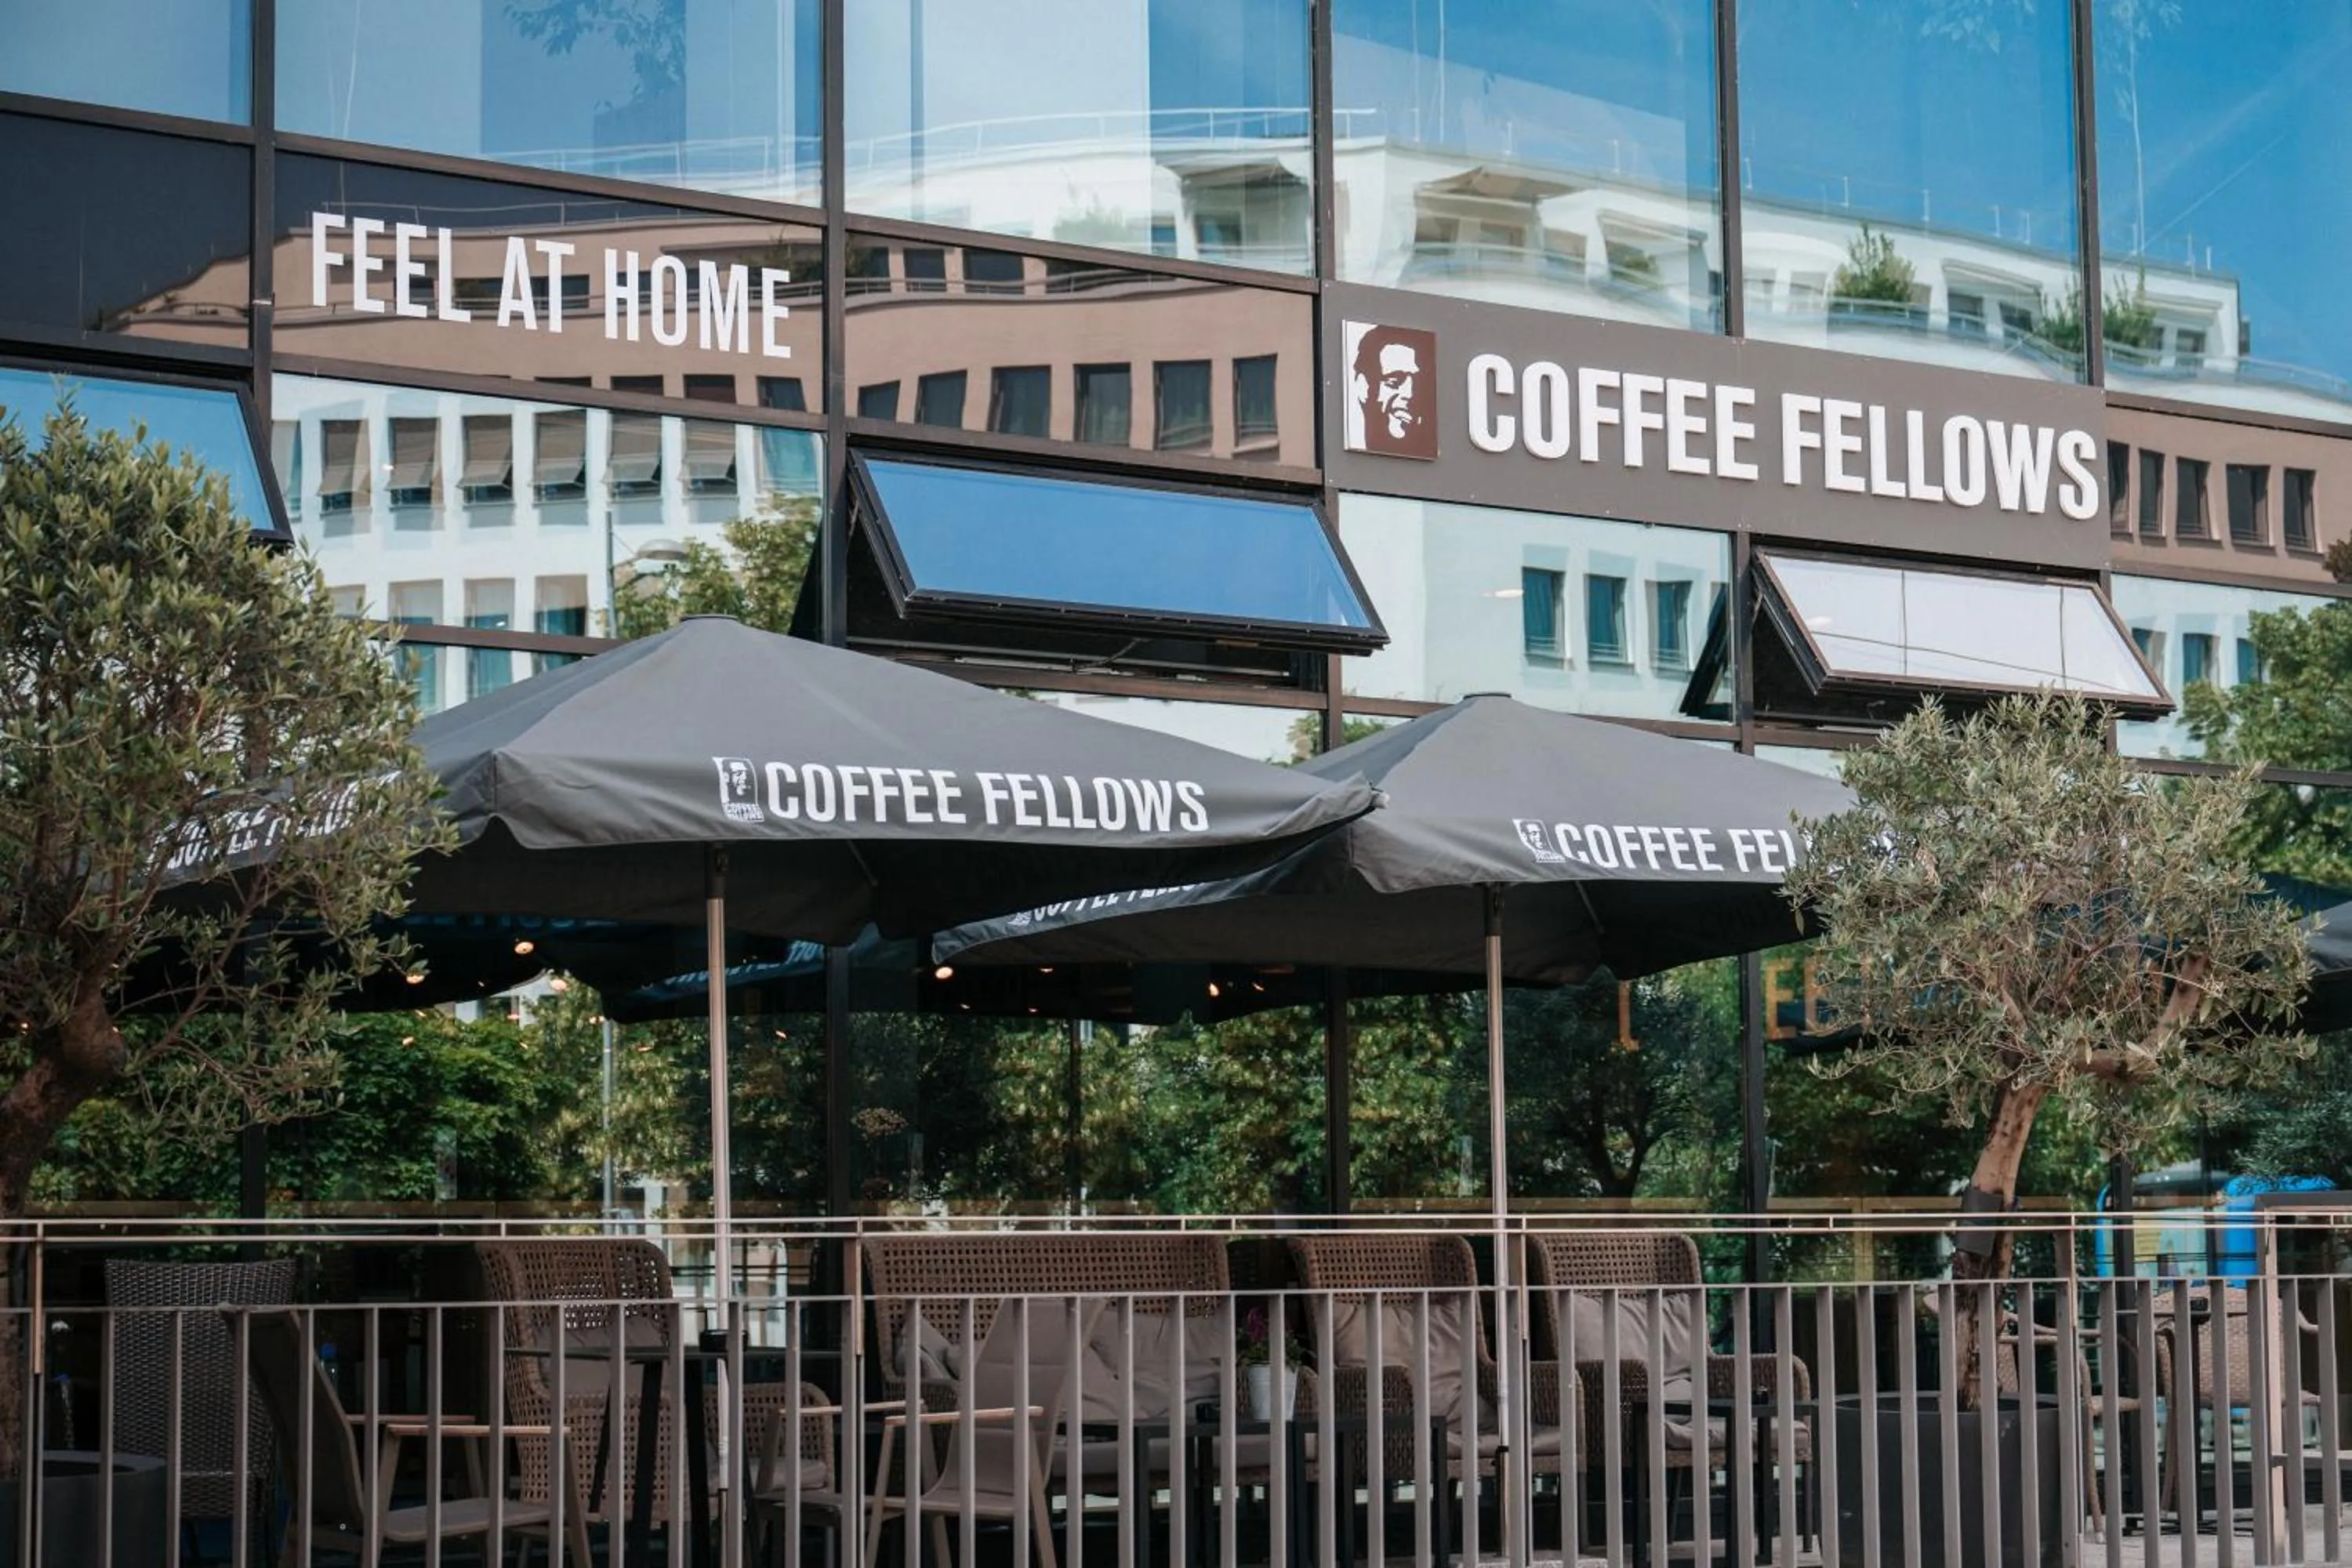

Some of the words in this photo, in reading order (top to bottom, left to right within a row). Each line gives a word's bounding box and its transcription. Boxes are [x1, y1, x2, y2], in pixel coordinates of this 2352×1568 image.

[313, 212, 471, 323] FEEL
[497, 236, 575, 332] AT
[604, 249, 791, 358] HOME
[1467, 353, 1759, 481] COFFEE
[1781, 393, 2099, 521] FELLOWS
[764, 761, 967, 823] COFFEE
[975, 771, 1210, 832] FELLOWS
[1554, 822, 1724, 871] COFFEE
